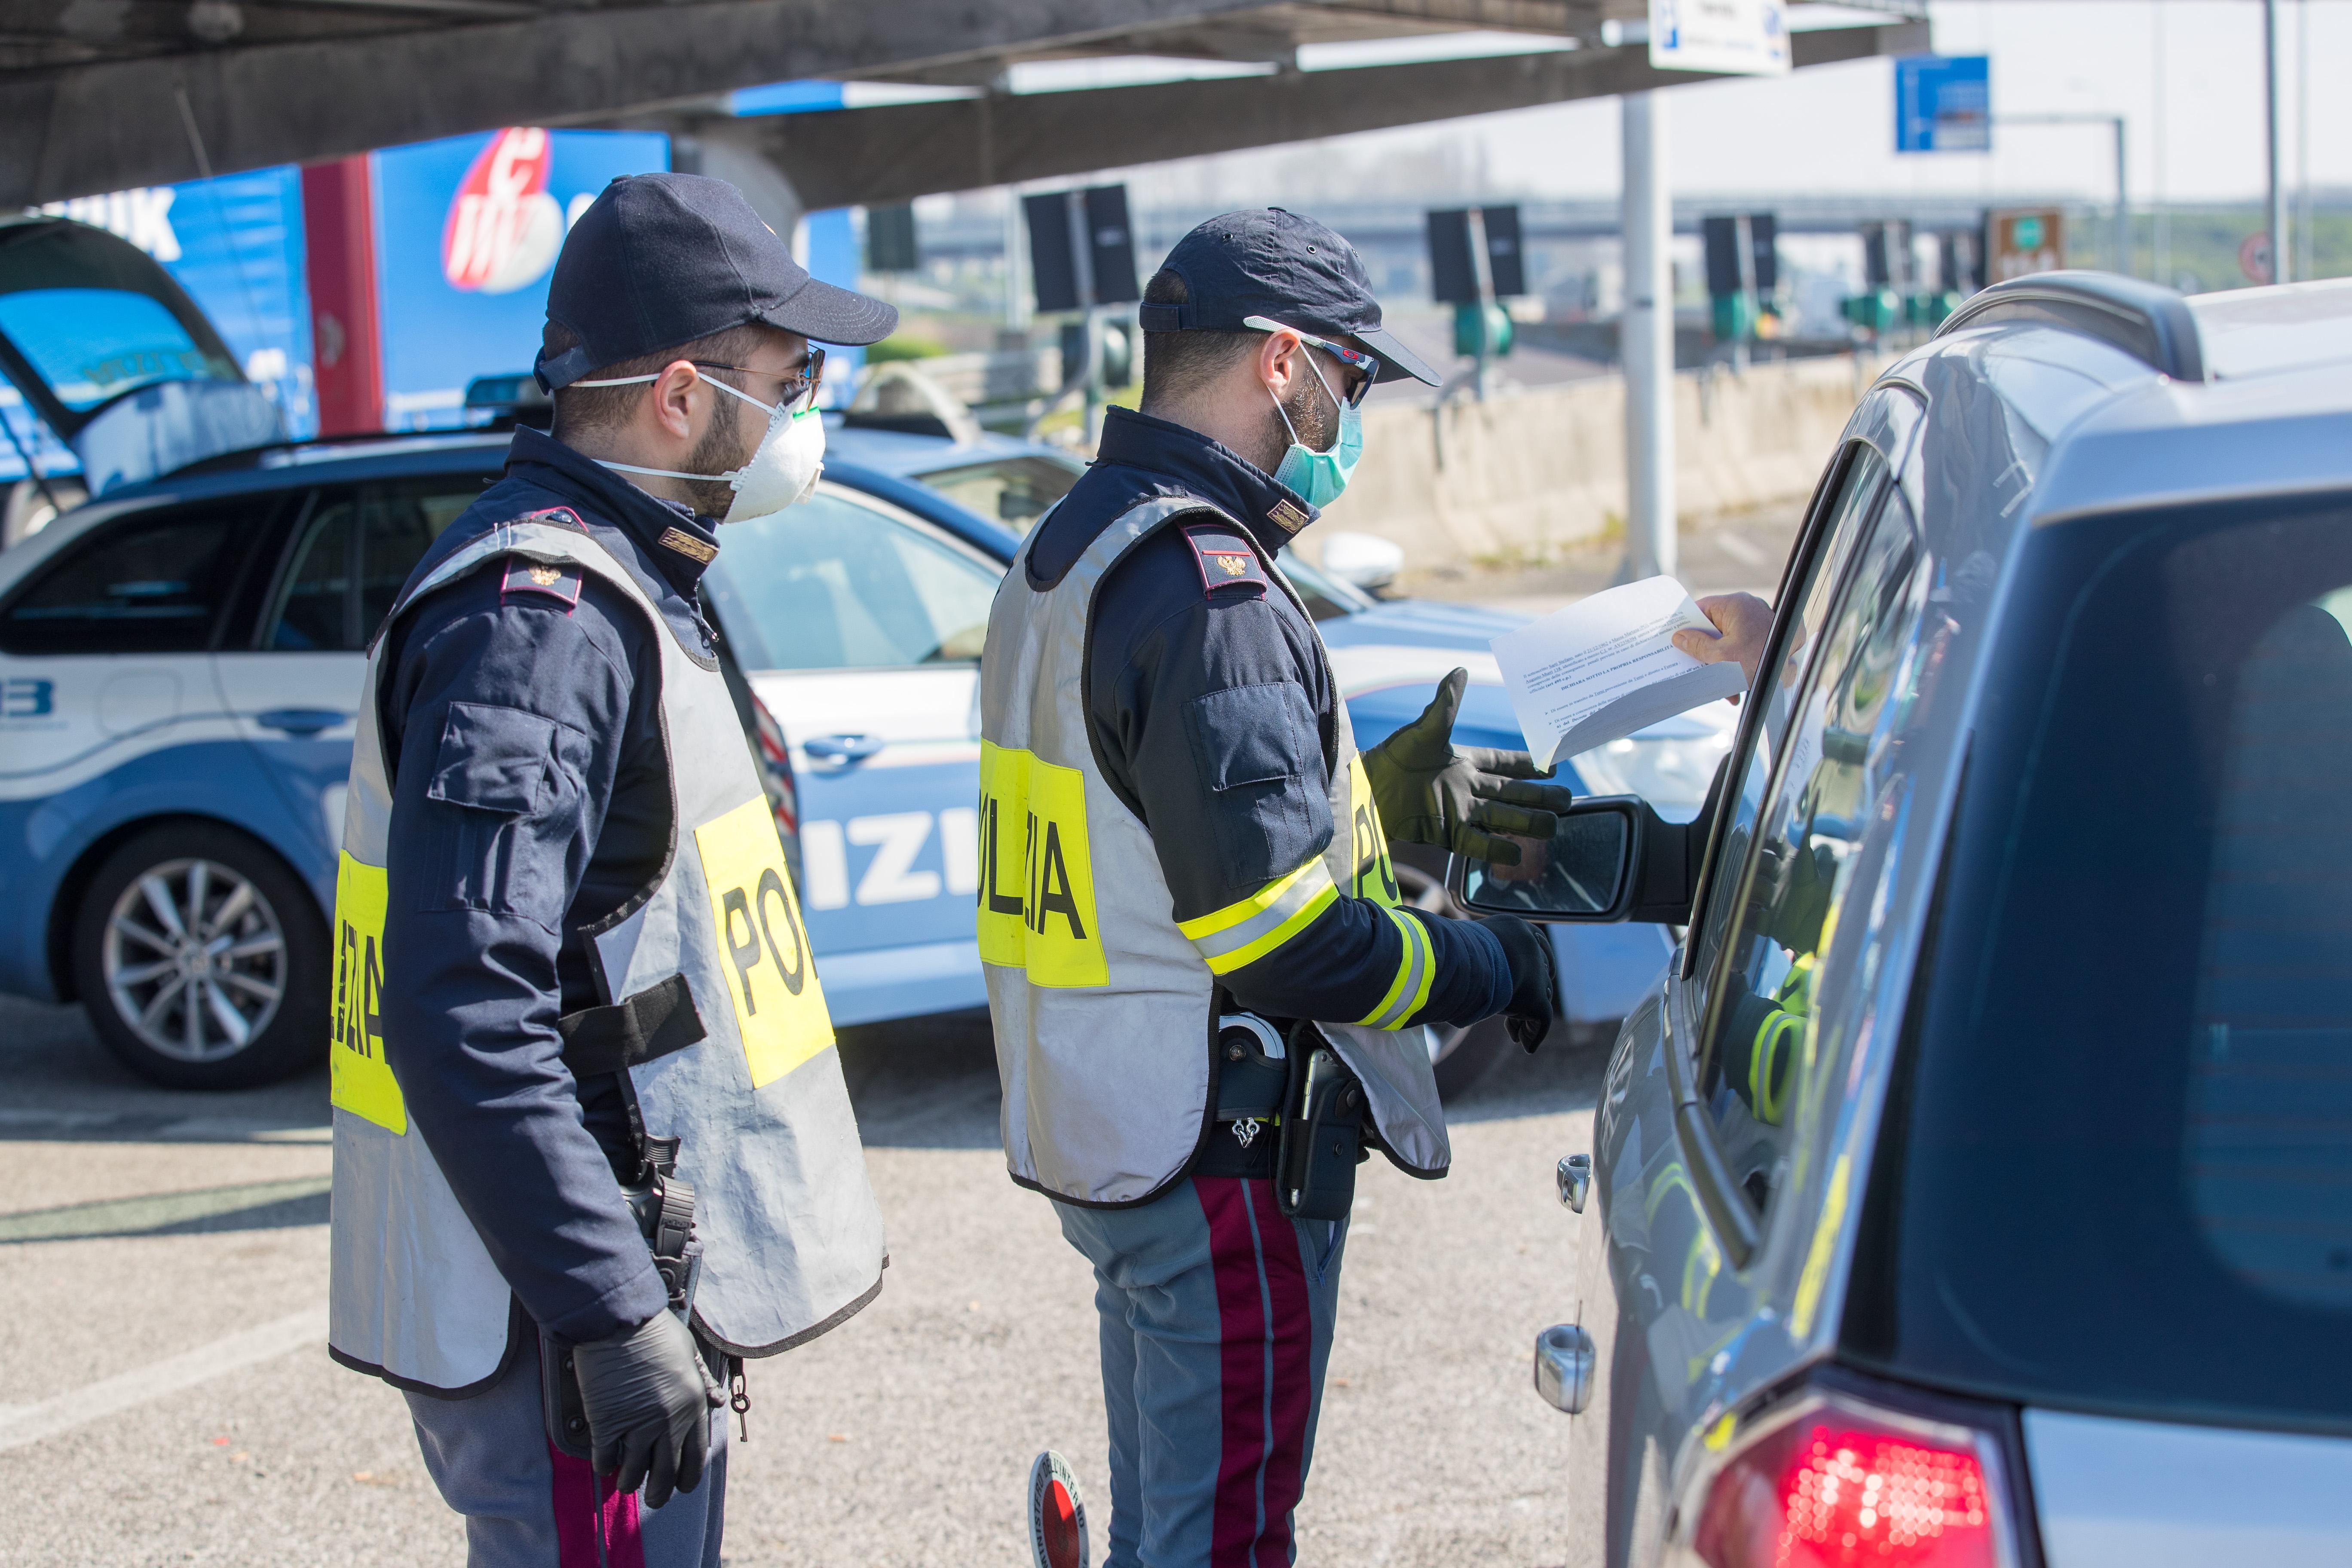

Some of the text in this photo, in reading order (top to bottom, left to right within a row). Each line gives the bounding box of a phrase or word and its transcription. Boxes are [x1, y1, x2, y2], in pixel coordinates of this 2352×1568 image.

[1561, 679, 1586, 691] DICHIARA
[1586, 671, 1602, 680] SOTTO
[1610, 661, 1632, 671] PROPRIA
[1574, 696, 1588, 704] transito
[1575, 704, 1597, 715] conoscenza
[1572, 714, 1587, 723] Decreto
